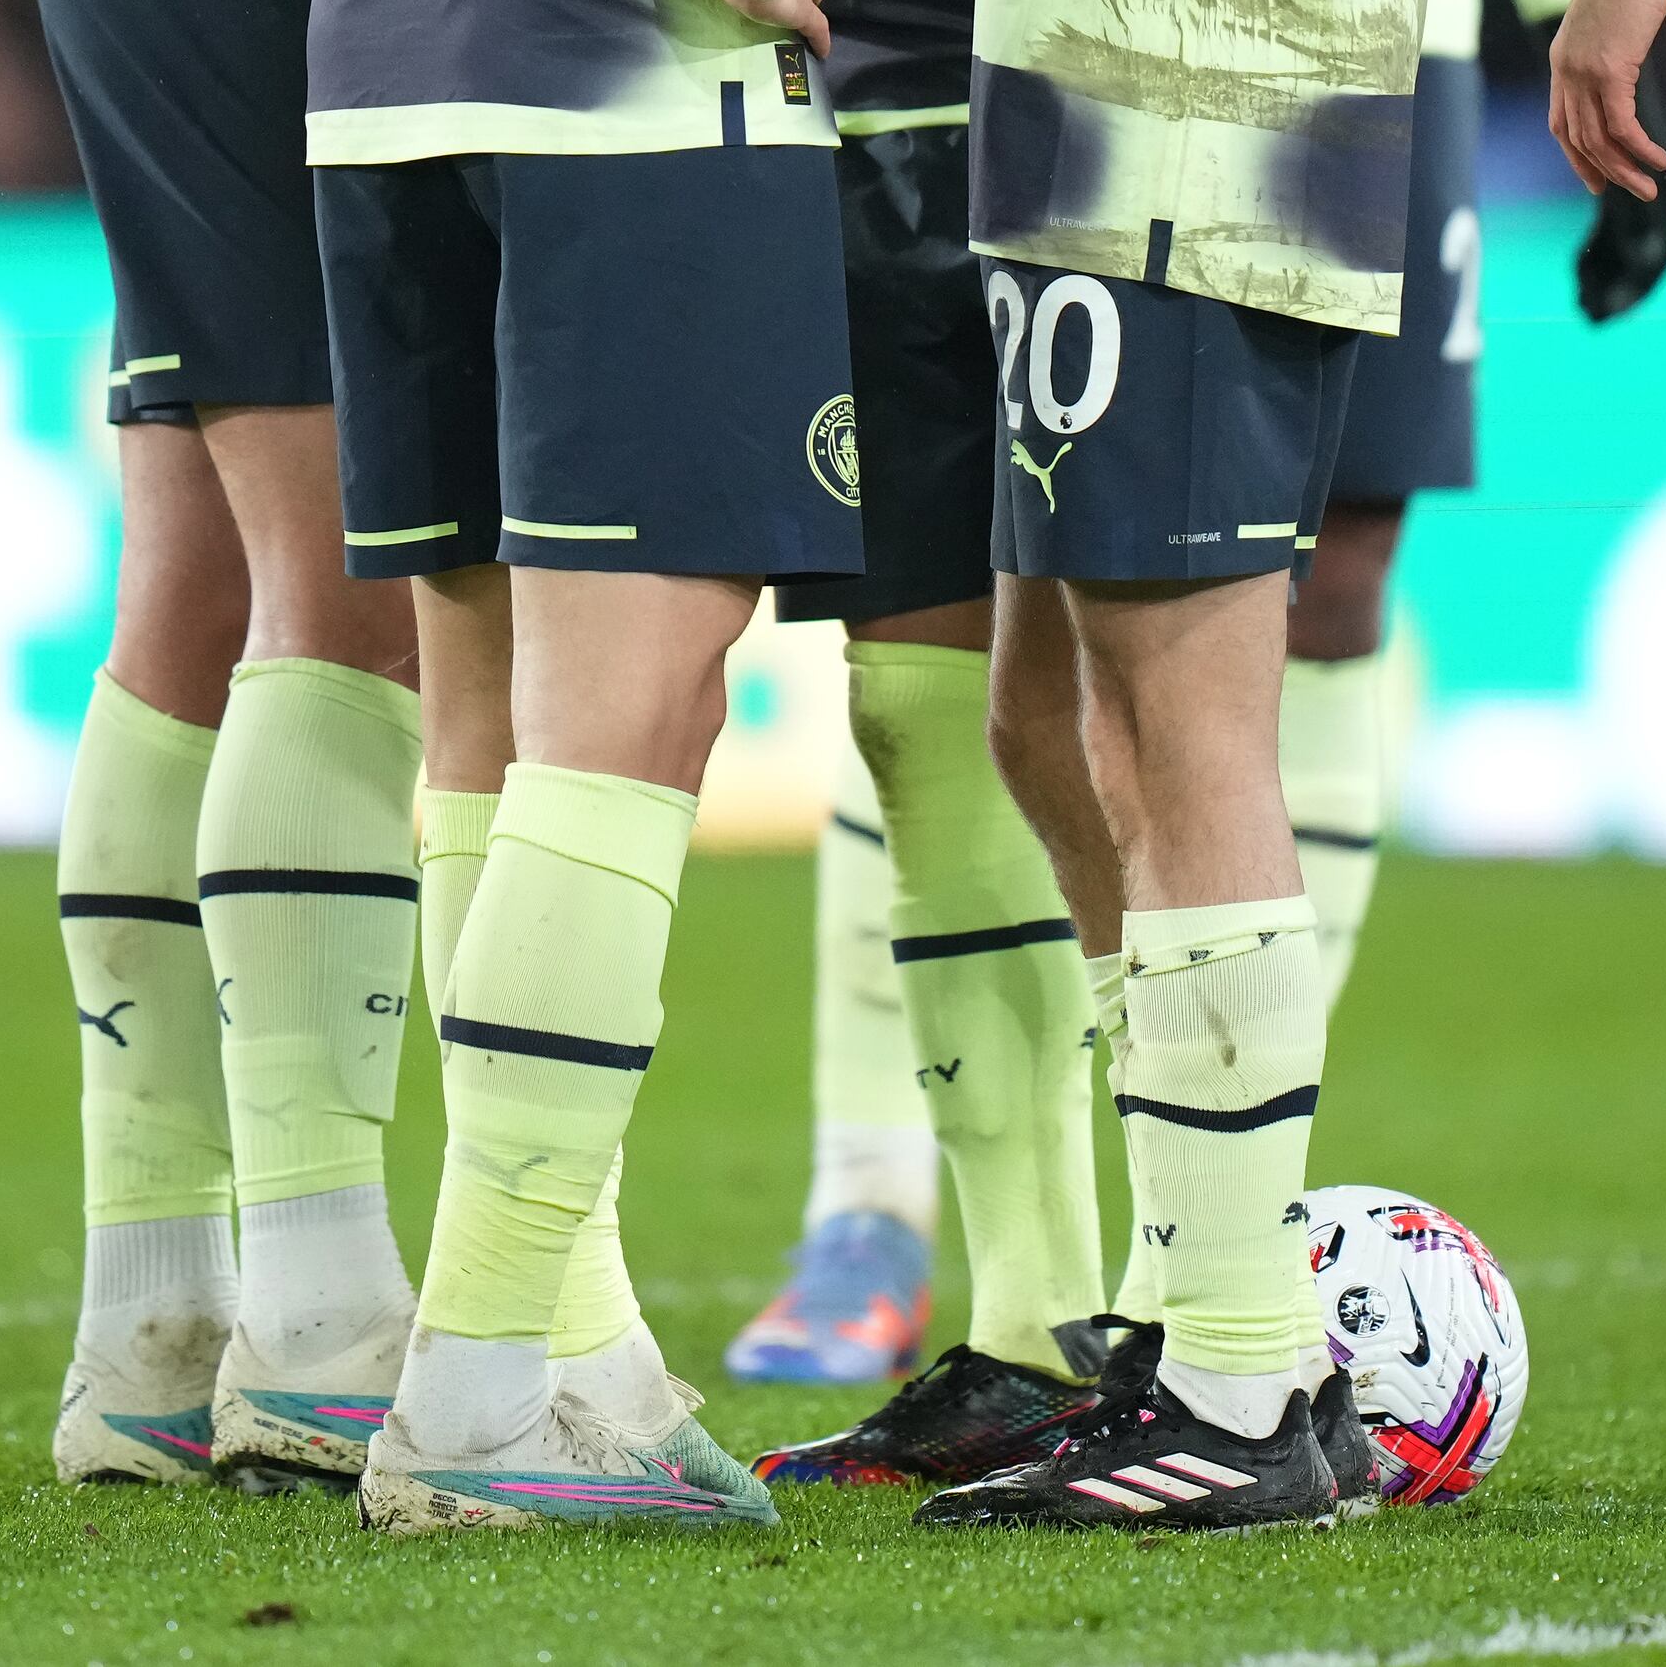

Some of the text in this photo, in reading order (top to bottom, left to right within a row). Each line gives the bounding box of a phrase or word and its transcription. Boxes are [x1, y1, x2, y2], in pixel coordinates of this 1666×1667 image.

[987, 269, 1121, 435] 20
[817, 402, 855, 438] MANCHE
[1168, 531, 1221, 545] ULTRAWEAVE
